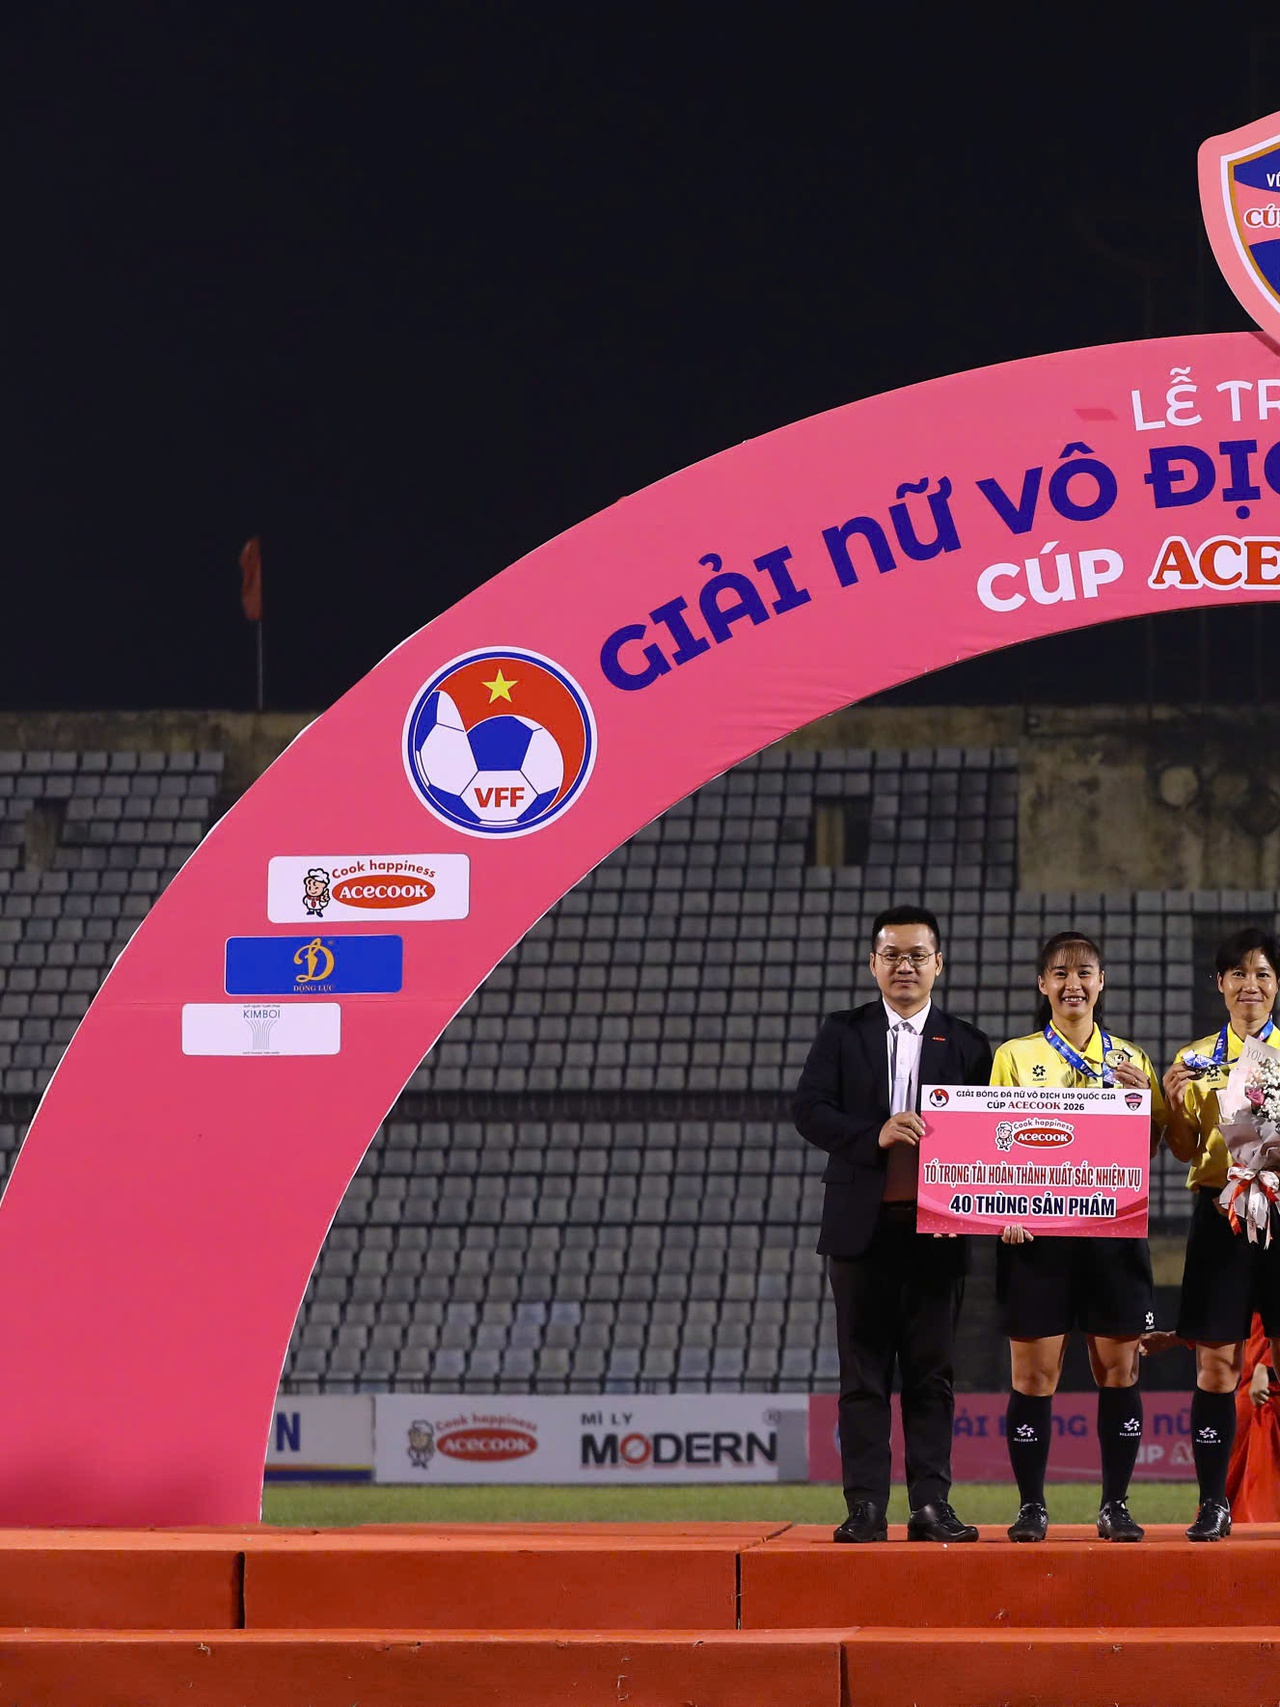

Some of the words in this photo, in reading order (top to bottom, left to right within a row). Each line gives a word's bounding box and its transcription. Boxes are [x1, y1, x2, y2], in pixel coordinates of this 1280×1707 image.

[1131, 367, 1203, 431] LỄ
[599, 545, 813, 692] GIẢI
[974, 441, 1118, 535] VÔ
[976, 540, 1125, 613] CÚP
[473, 786, 525, 809] VFF
[331, 861, 365, 879] Cook
[369, 859, 436, 878] happiness
[243, 1009, 281, 1019] KIMBOI
[956, 1090, 975, 1098] GIẢI
[1000, 1090, 1012, 1099] ĐÁ
[1027, 1090, 1039, 1099] VÔ
[1040, 1092, 1060, 1101] ĐỊCH
[1061, 1092, 1076, 1100] U19
[1077, 1091, 1100, 1101] QUỐC
[986, 1100, 1006, 1109] CÚP
[1007, 1101, 1061, 1110] ACECOOK
[1063, 1103, 1085, 1111] 2026
[1013, 1120, 1033, 1130] Cook
[1034, 1118, 1074, 1131] happiness
[925, 1159, 939, 1183] TỔ
[938, 1164, 970, 1186] TRỌNG
[971, 1162, 988, 1183] TÀI
[988, 1162, 1014, 1184] HOÀN
[1015, 1161, 1048, 1185] THÀNH
[1049, 1162, 1073, 1185] XUẤT
[1074, 1161, 1094, 1185] SẮC
[1095, 1164, 1125, 1190] NHIỆM
[1127, 1168, 1142, 1191] VỤ
[950, 1195, 971, 1213] 40
[976, 1192, 1028, 1214] THÙNG
[1032, 1192, 1064, 1215] SẢN
[1068, 1192, 1116, 1216] PHẨM
[435, 1416, 468, 1432] Cook
[472, 1413, 538, 1431] happiness
[610, 1412, 634, 1425] LY
[580, 1431, 778, 1467] MODERN
